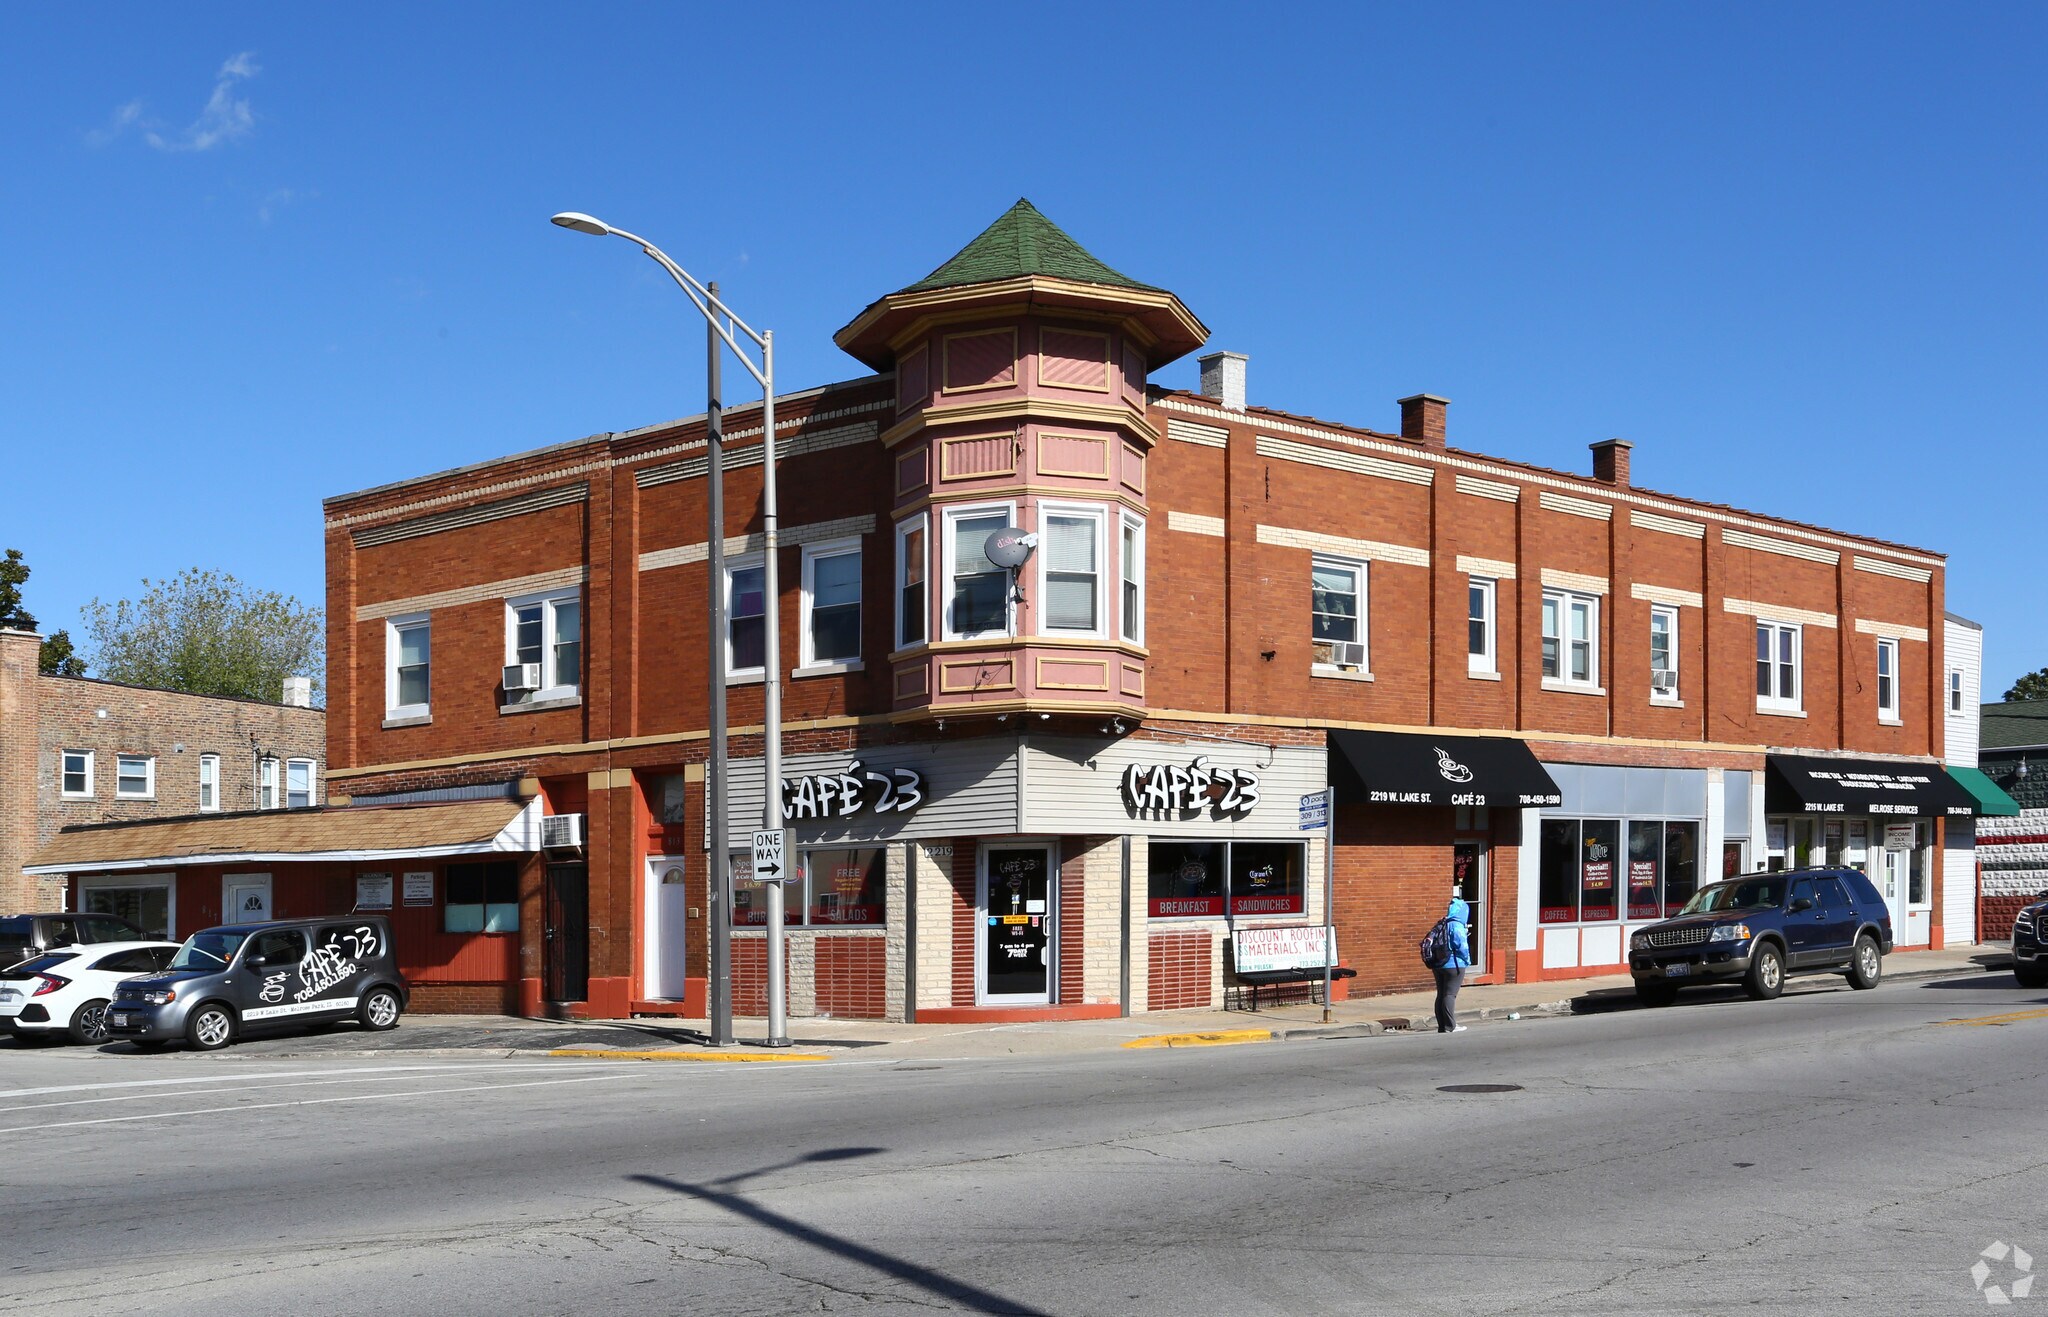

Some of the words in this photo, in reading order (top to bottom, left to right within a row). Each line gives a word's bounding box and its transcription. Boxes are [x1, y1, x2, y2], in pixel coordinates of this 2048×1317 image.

[997, 536, 1015, 549] dish
[1129, 755, 1212, 809] CAFÉ
[1215, 768, 1261, 812] 23
[866, 768, 922, 814] 23
[1370, 791, 1388, 802] 2219
[1388, 792, 1398, 802] W.
[1399, 792, 1420, 802] LAKE
[1420, 793, 1431, 803] ST.
[1451, 792, 1474, 805] CAFÉ
[1475, 795, 1485, 805] 23
[1519, 795, 1560, 804] 708-450-1590
[1805, 803, 1816, 811] 2215
[1823, 803, 1837, 812] LAKE
[1869, 804, 1894, 813] MELROSE
[1894, 805, 1918, 814] SERVICES
[756, 833, 781, 846] ONE
[756, 847, 781, 861] WAY
[926, 847, 952, 856] 2219
[837, 868, 861, 877] FREE
[1160, 901, 1209, 914] BREAKFAST
[1237, 899, 1290, 912] SANDWICHES
[1639, 906, 1656, 916] SHAKES
[830, 909, 868, 921] SALADS
[1544, 910, 1568, 920] COFFEE
[1584, 909, 1609, 918] ESPRESSO
[1238, 929, 1285, 944] DISCOUNT
[1290, 927, 1327, 941] ROOFIN
[299, 932, 347, 987] CAFÉ
[342, 926, 376, 959] 23
[293, 963, 356, 1003] 708.450.1590
